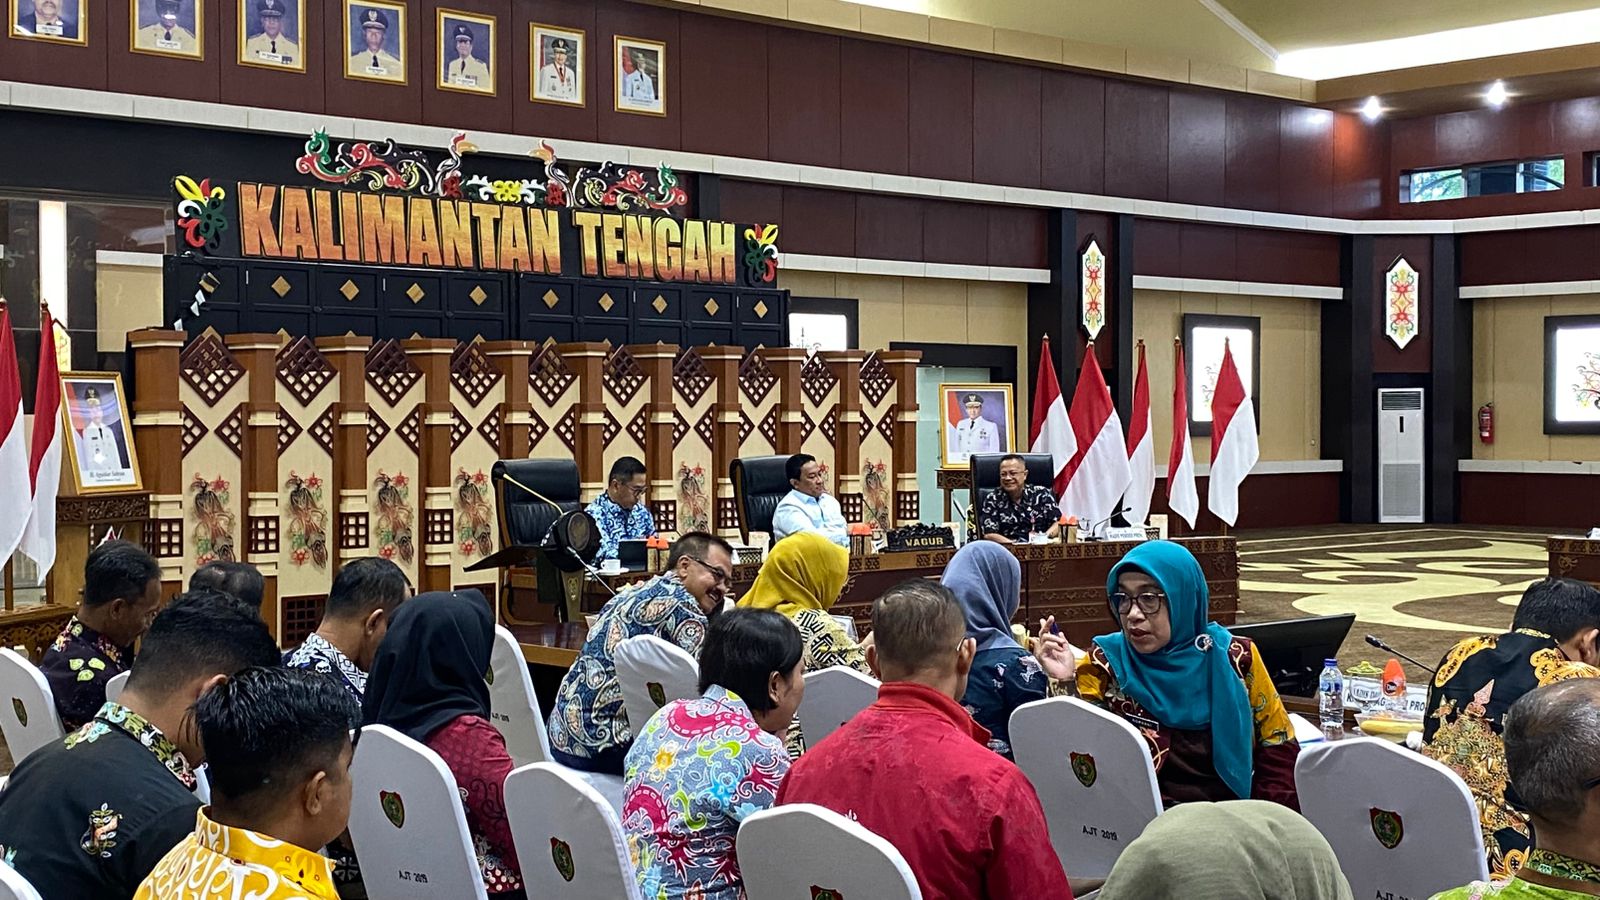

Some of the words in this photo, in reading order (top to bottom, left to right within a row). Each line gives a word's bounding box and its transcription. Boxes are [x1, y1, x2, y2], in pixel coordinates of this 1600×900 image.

[236, 181, 562, 275] KALIMANTAN
[572, 209, 736, 284] TENGAH
[1082, 824, 1098, 836] AJT
[1100, 829, 1118, 841] 2019
